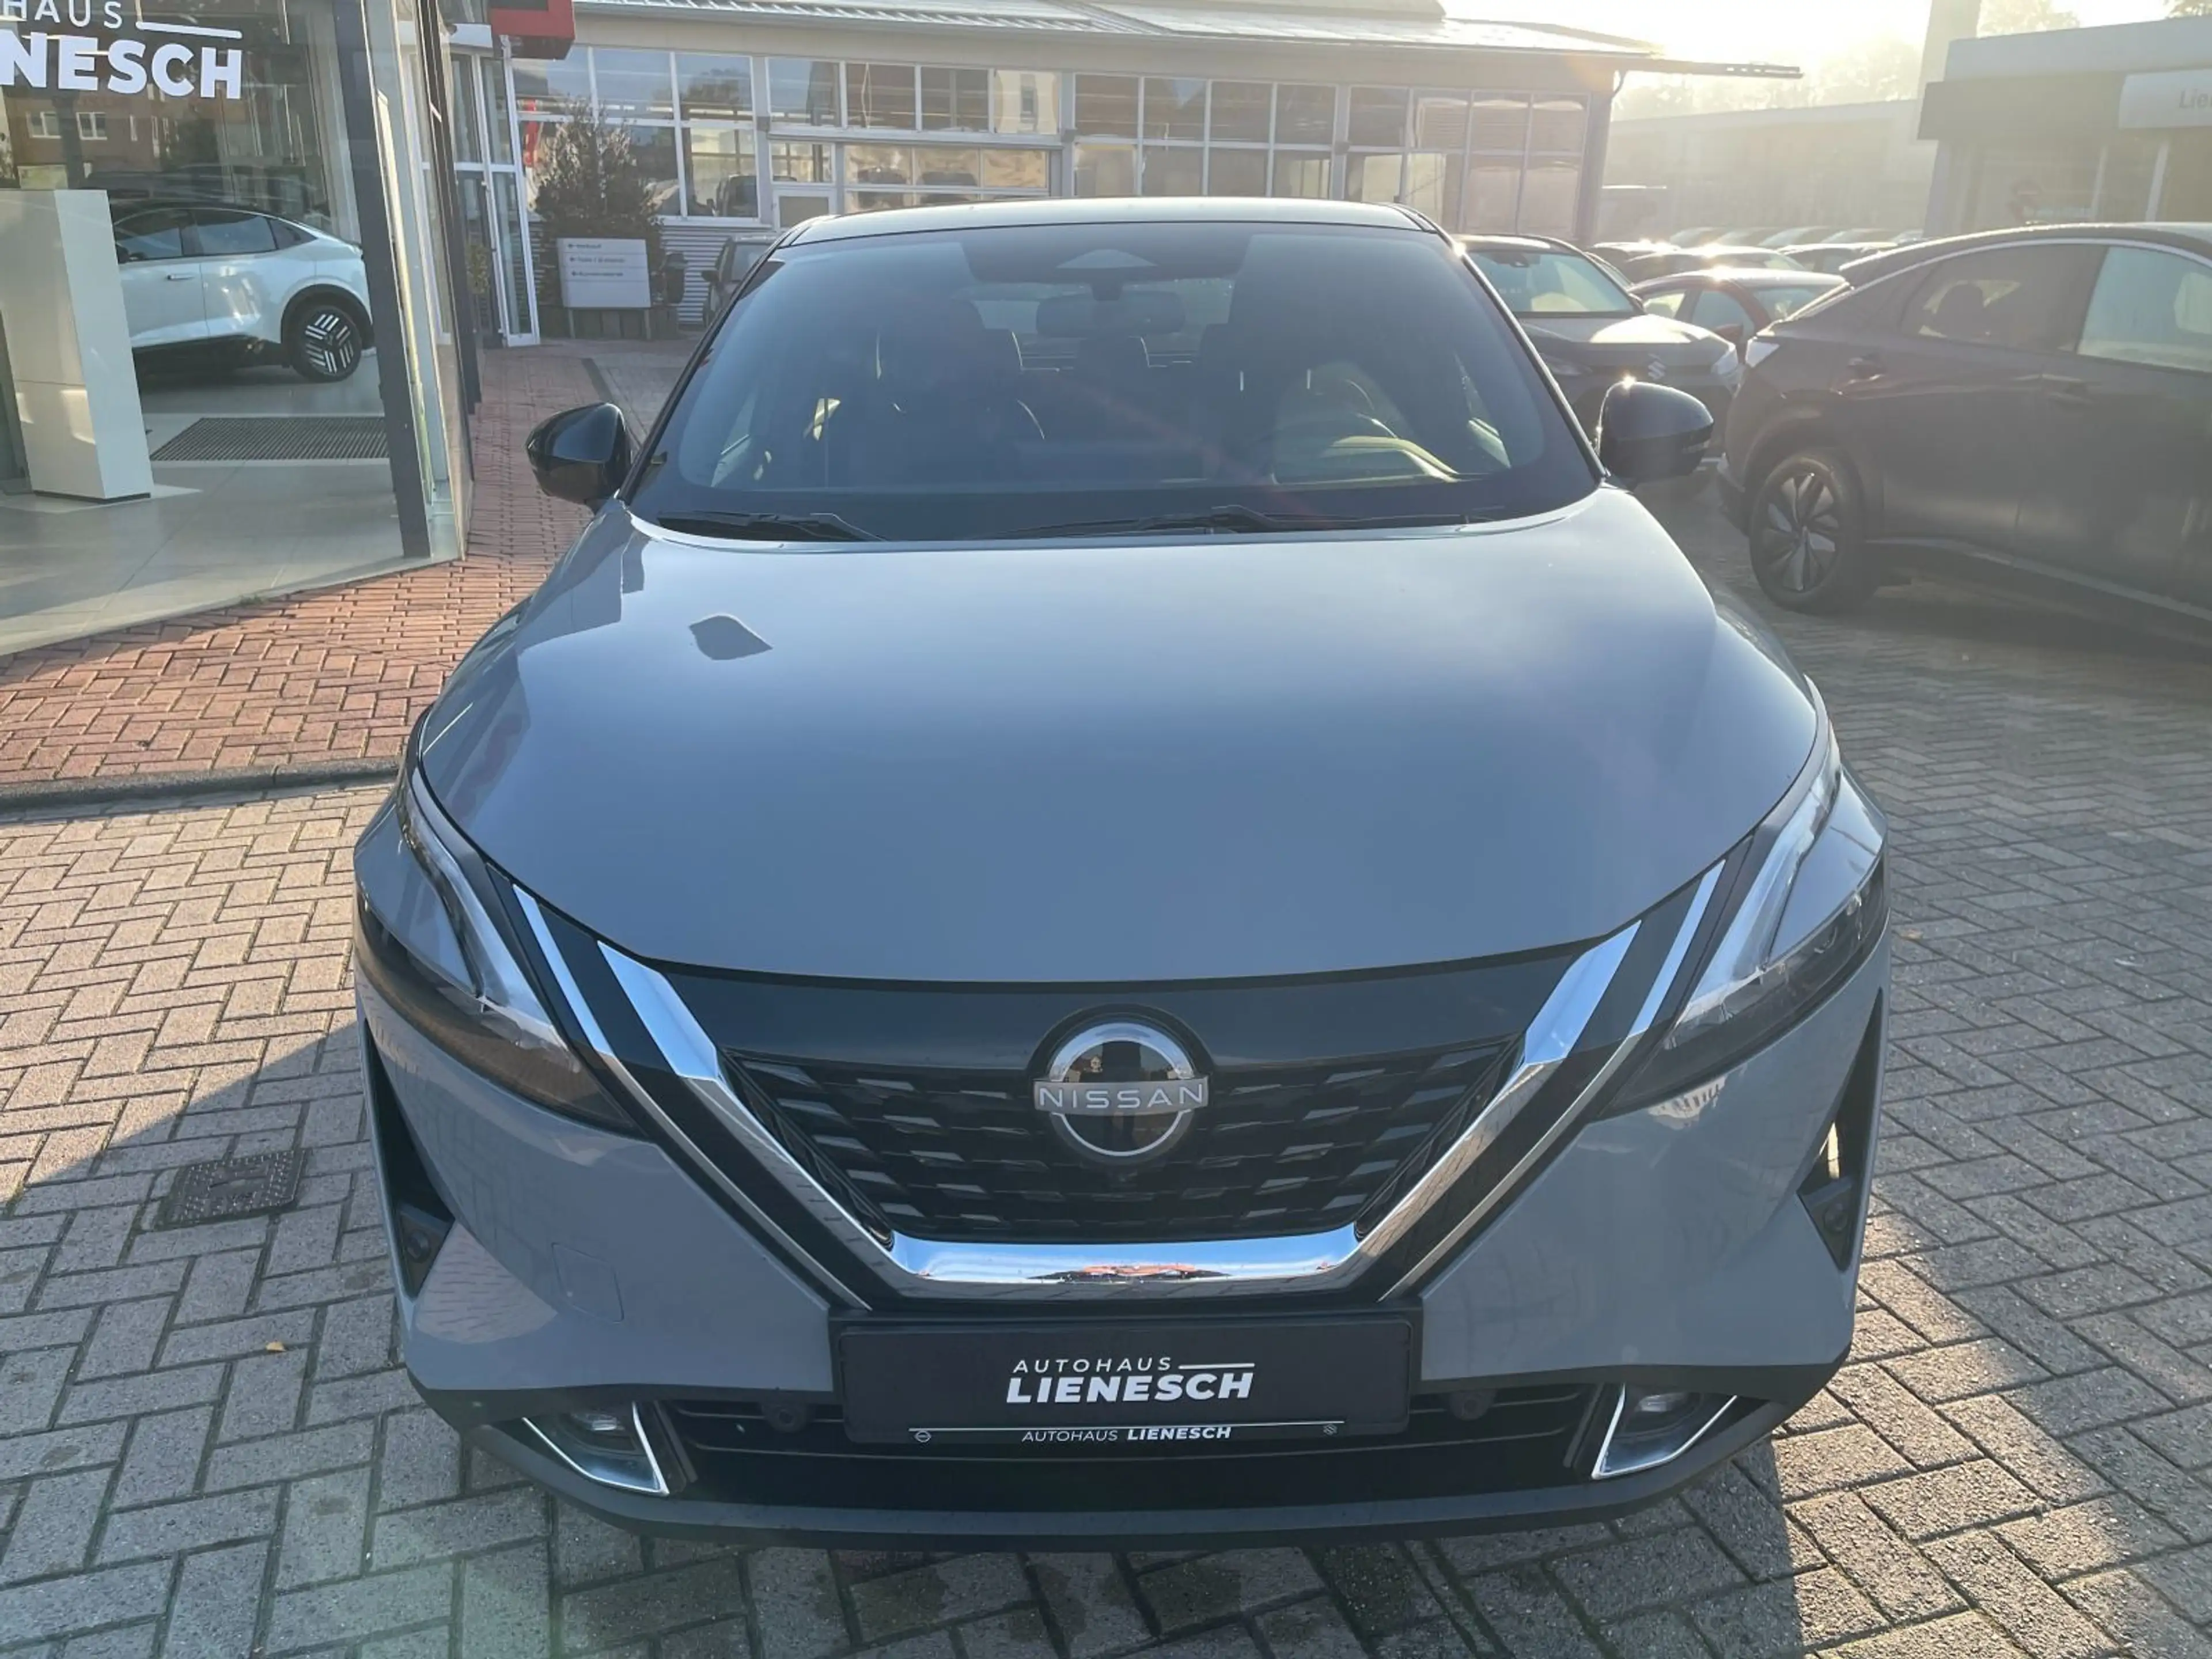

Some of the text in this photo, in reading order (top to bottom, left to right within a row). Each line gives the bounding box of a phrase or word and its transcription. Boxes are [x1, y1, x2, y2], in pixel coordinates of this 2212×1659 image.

[2179, 88, 2212, 109] Lie
[1039, 1084, 1203, 1108] NISSAN
[1012, 1357, 1172, 1373] AUTOHAUS
[1006, 1372, 1254, 1403] LIENESCH
[1021, 1426, 1232, 1442] AUTOHAUS LIENESCH
